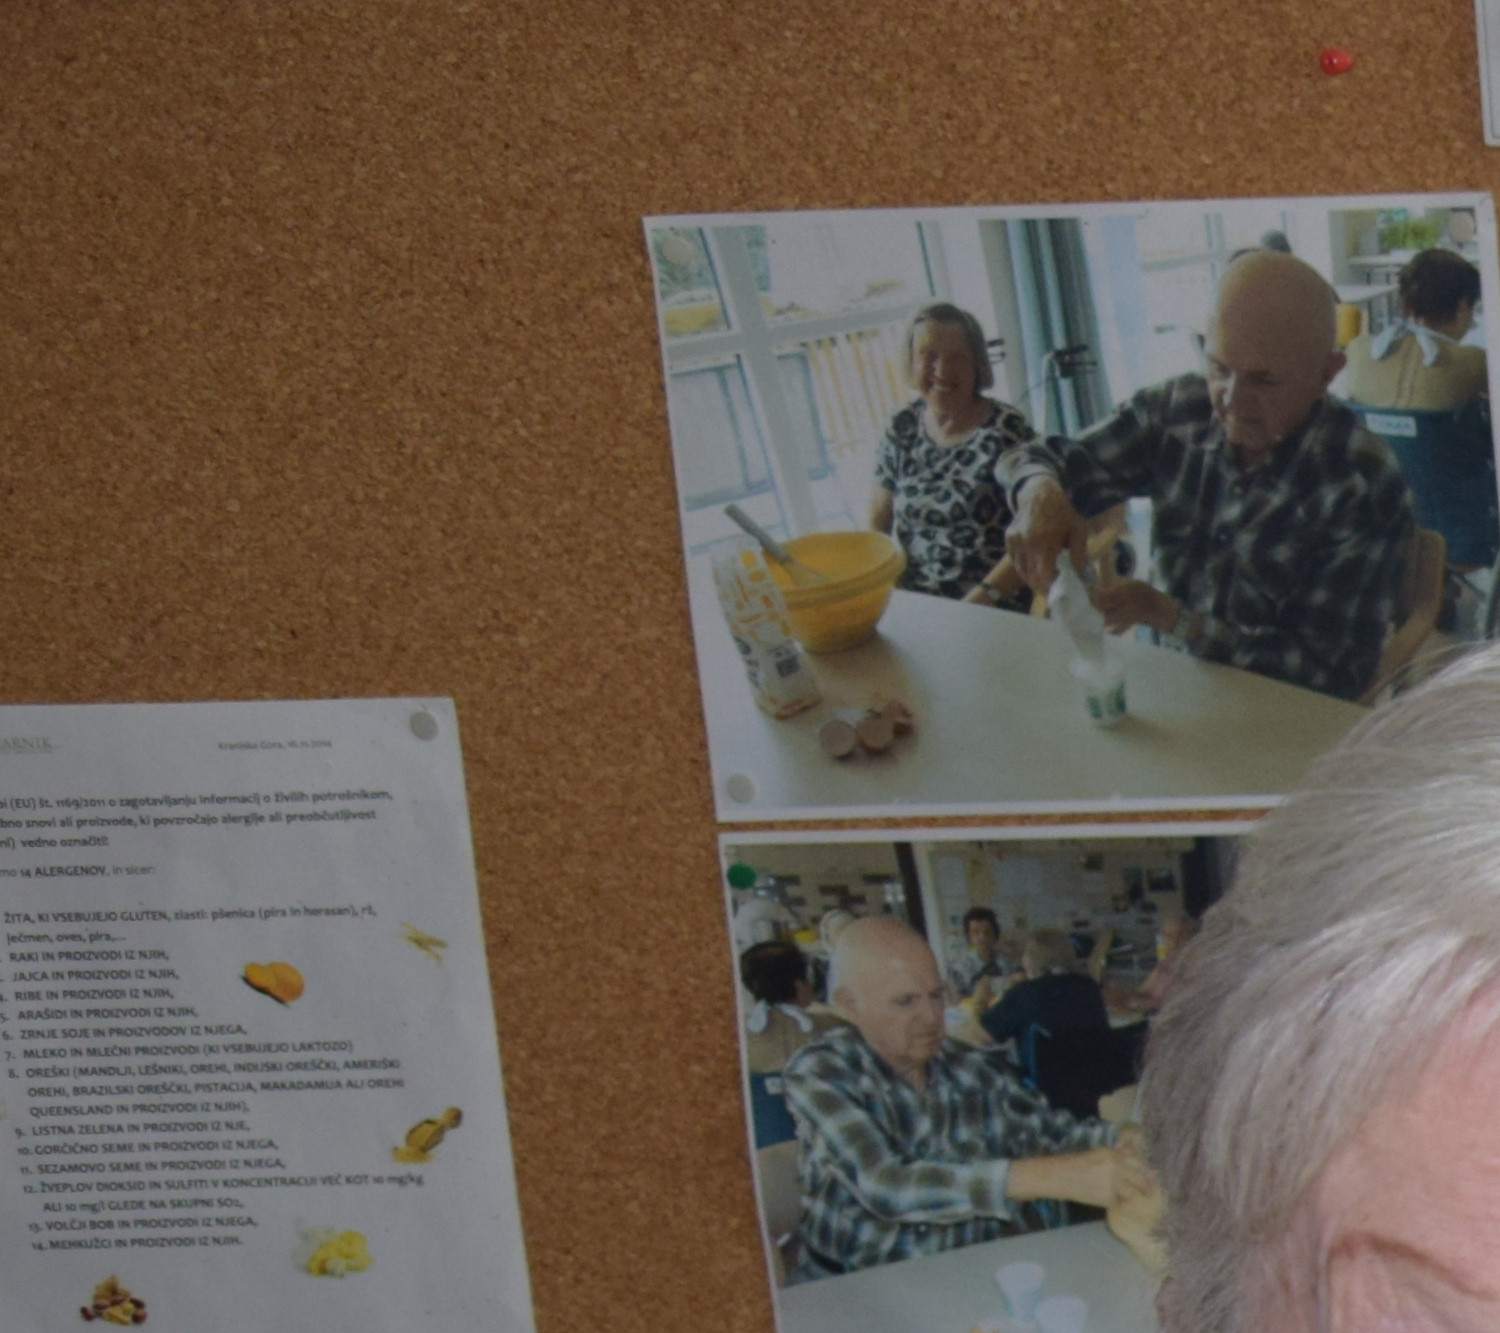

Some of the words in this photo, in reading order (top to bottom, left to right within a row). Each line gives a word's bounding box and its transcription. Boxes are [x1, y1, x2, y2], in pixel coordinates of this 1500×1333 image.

[9, 952, 39, 962] RAKI
[41, 952, 55, 961] IN
[57, 950, 122, 961] PROIZVODI
[51, 971, 64, 980] IN
[67, 969, 132, 980] PROIZVODI
[14, 991, 42, 1001] RIBE
[46, 990, 59, 1000] IN
[62, 989, 126, 1000] PROIZVODI
[70, 1009, 83, 1019] IN
[85, 1008, 151, 1019] PROIZVODI
[93, 1028, 106, 1037] IN
